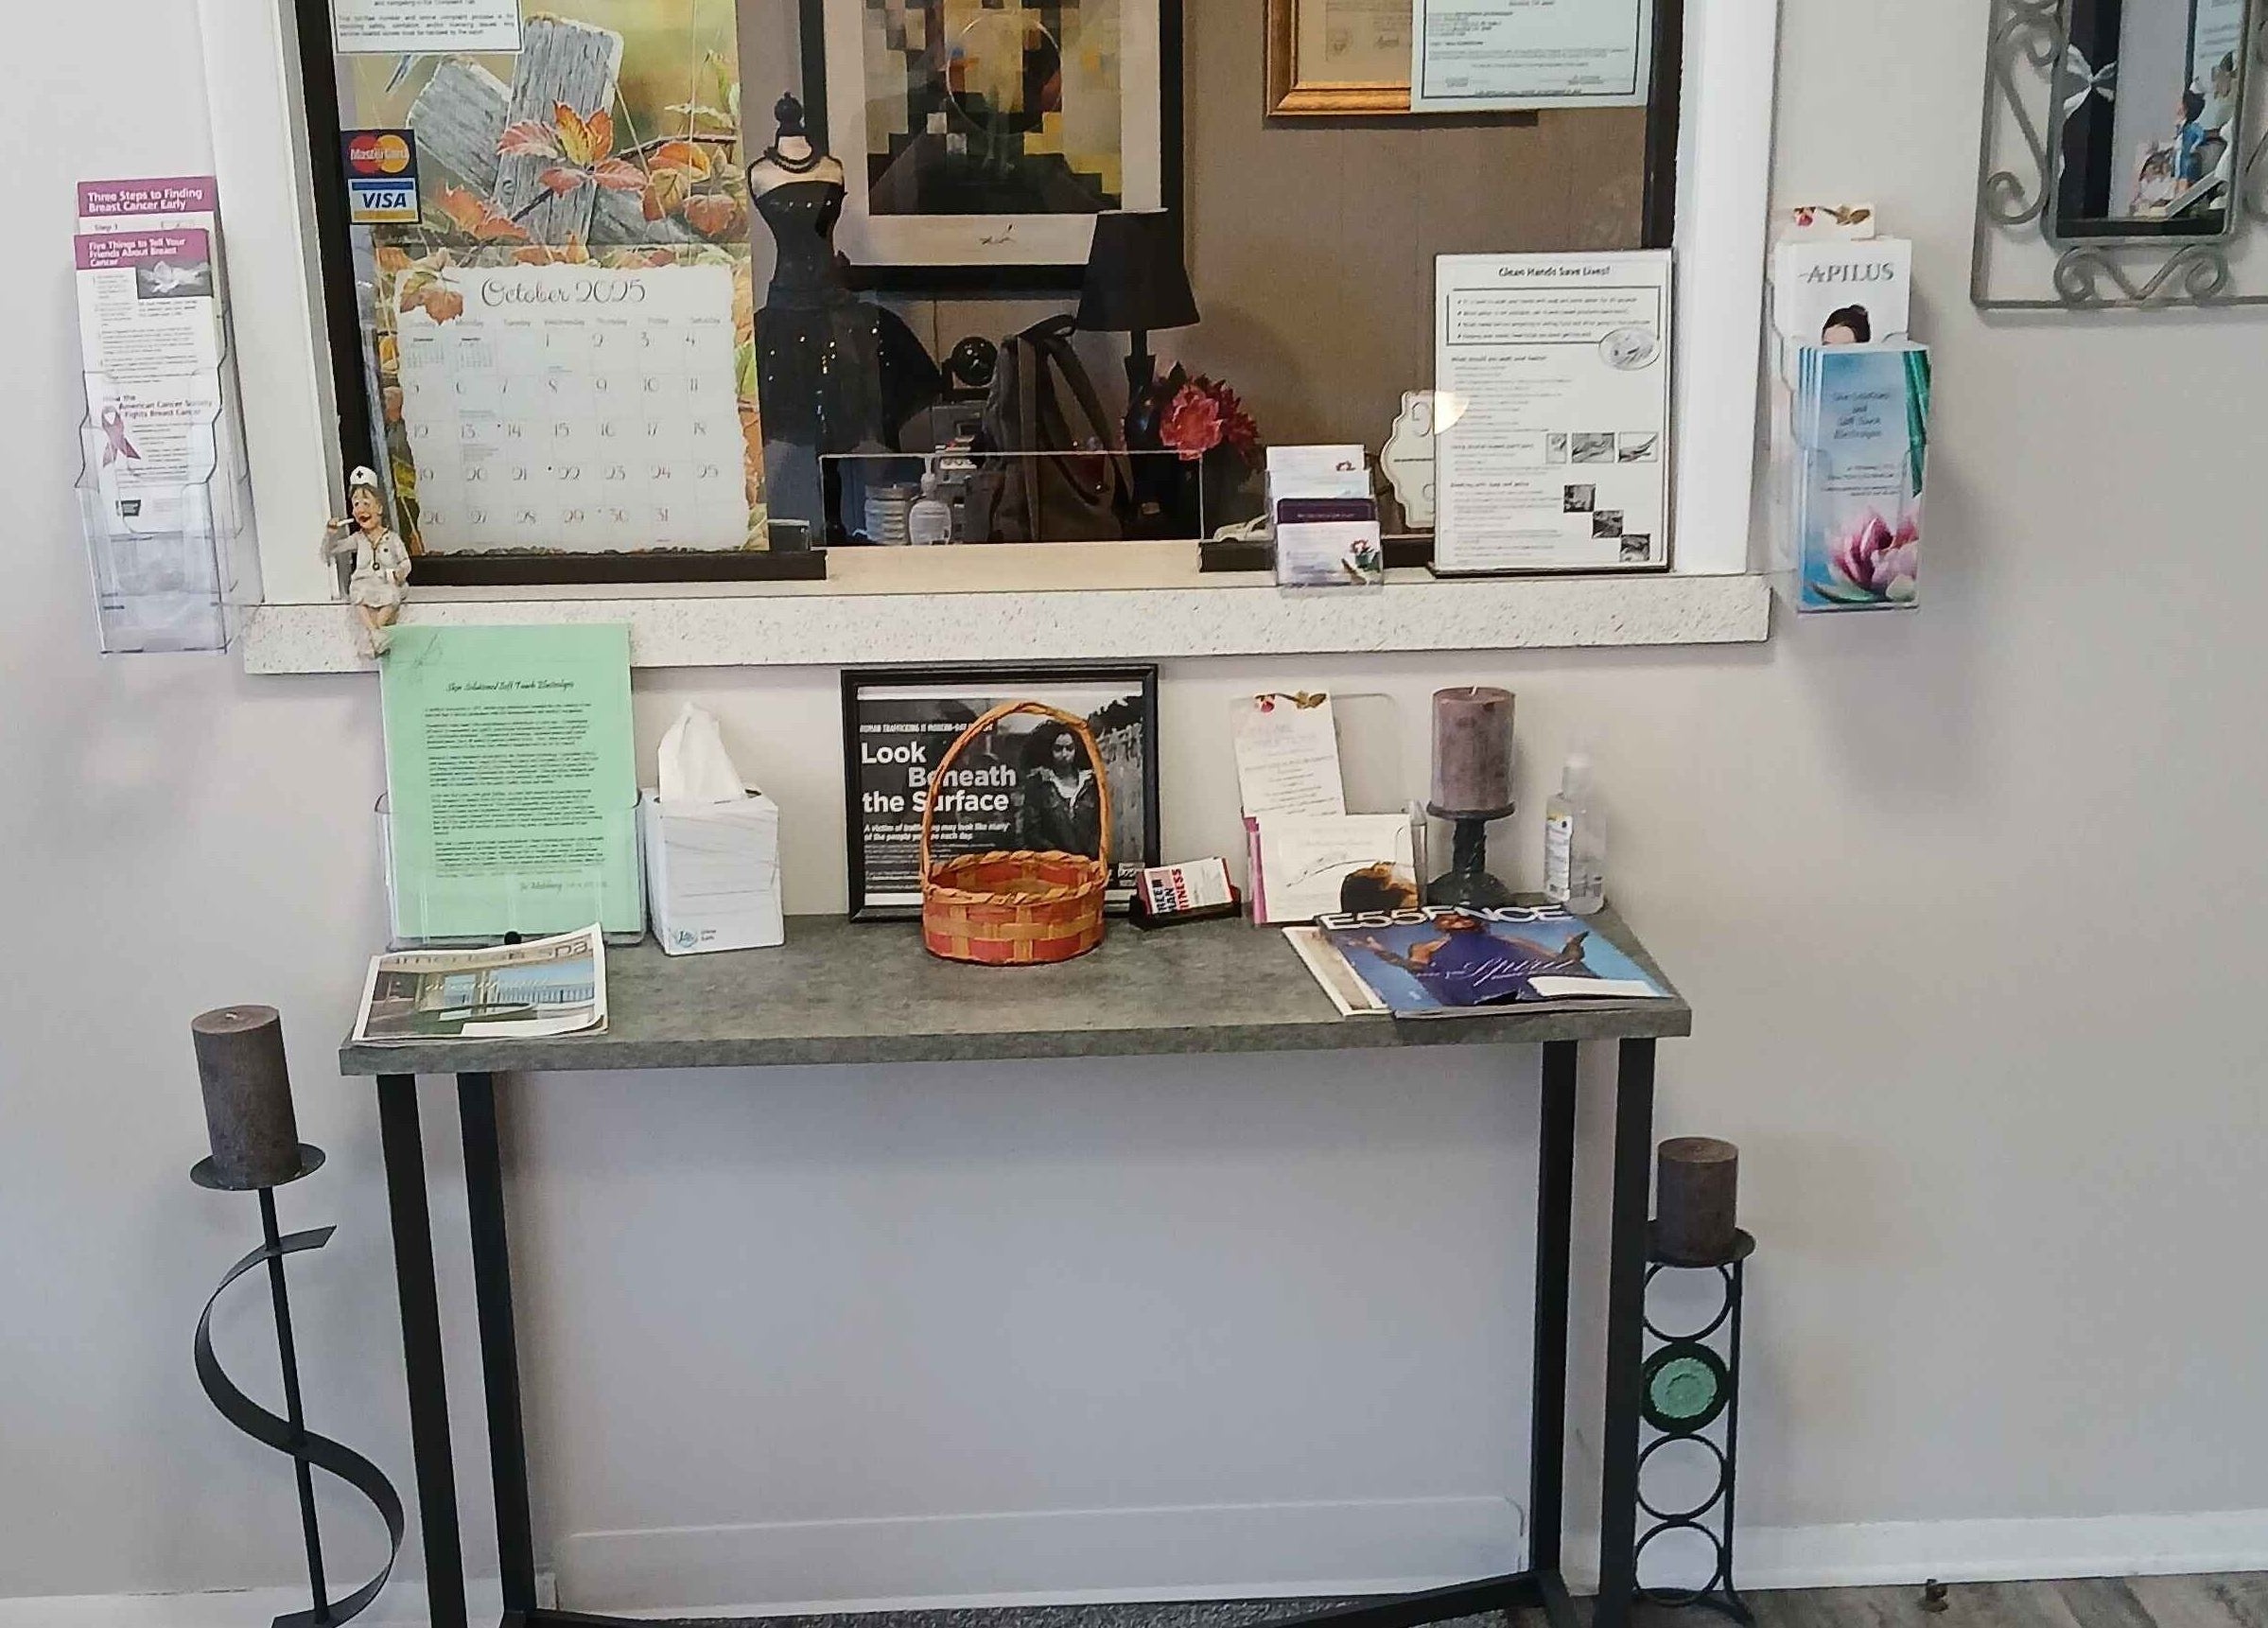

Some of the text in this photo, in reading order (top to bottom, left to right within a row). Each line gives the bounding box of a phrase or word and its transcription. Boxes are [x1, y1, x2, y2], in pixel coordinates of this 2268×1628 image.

[87, 188, 202, 203] Three Steps to Finding
[362, 192, 407, 208] VISA
[88, 199, 186, 213] Breast Cancer Early
[88, 237, 185, 251] Five Things to Tell Your
[89, 247, 178, 258] Friends About Breast
[90, 257, 119, 268] Cancer
[1498, 267, 1526, 277] Clean
[1527, 266, 1557, 277] Hands
[1558, 266, 1580, 276] Save
[1799, 262, 1894, 283] APILUS
[480, 278, 647, 306] October 2025
[596, 378, 607, 393] 9
[461, 423, 476, 438] 13
[508, 424, 521, 438] 14
[554, 423, 569, 437] 15
[601, 423, 615, 437] 16
[647, 423, 658, 436] 17
[512, 466, 528, 481] 21
[558, 465, 581, 481] 22
[605, 464, 626, 481] 23
[651, 464, 671, 479] 24
[698, 464, 719, 479] 25
[656, 507, 669, 521] 31
[861, 741, 927, 764] Look
[862, 790, 905, 813] the
[864, 824, 870, 832] A
[873, 832, 885, 841] the
